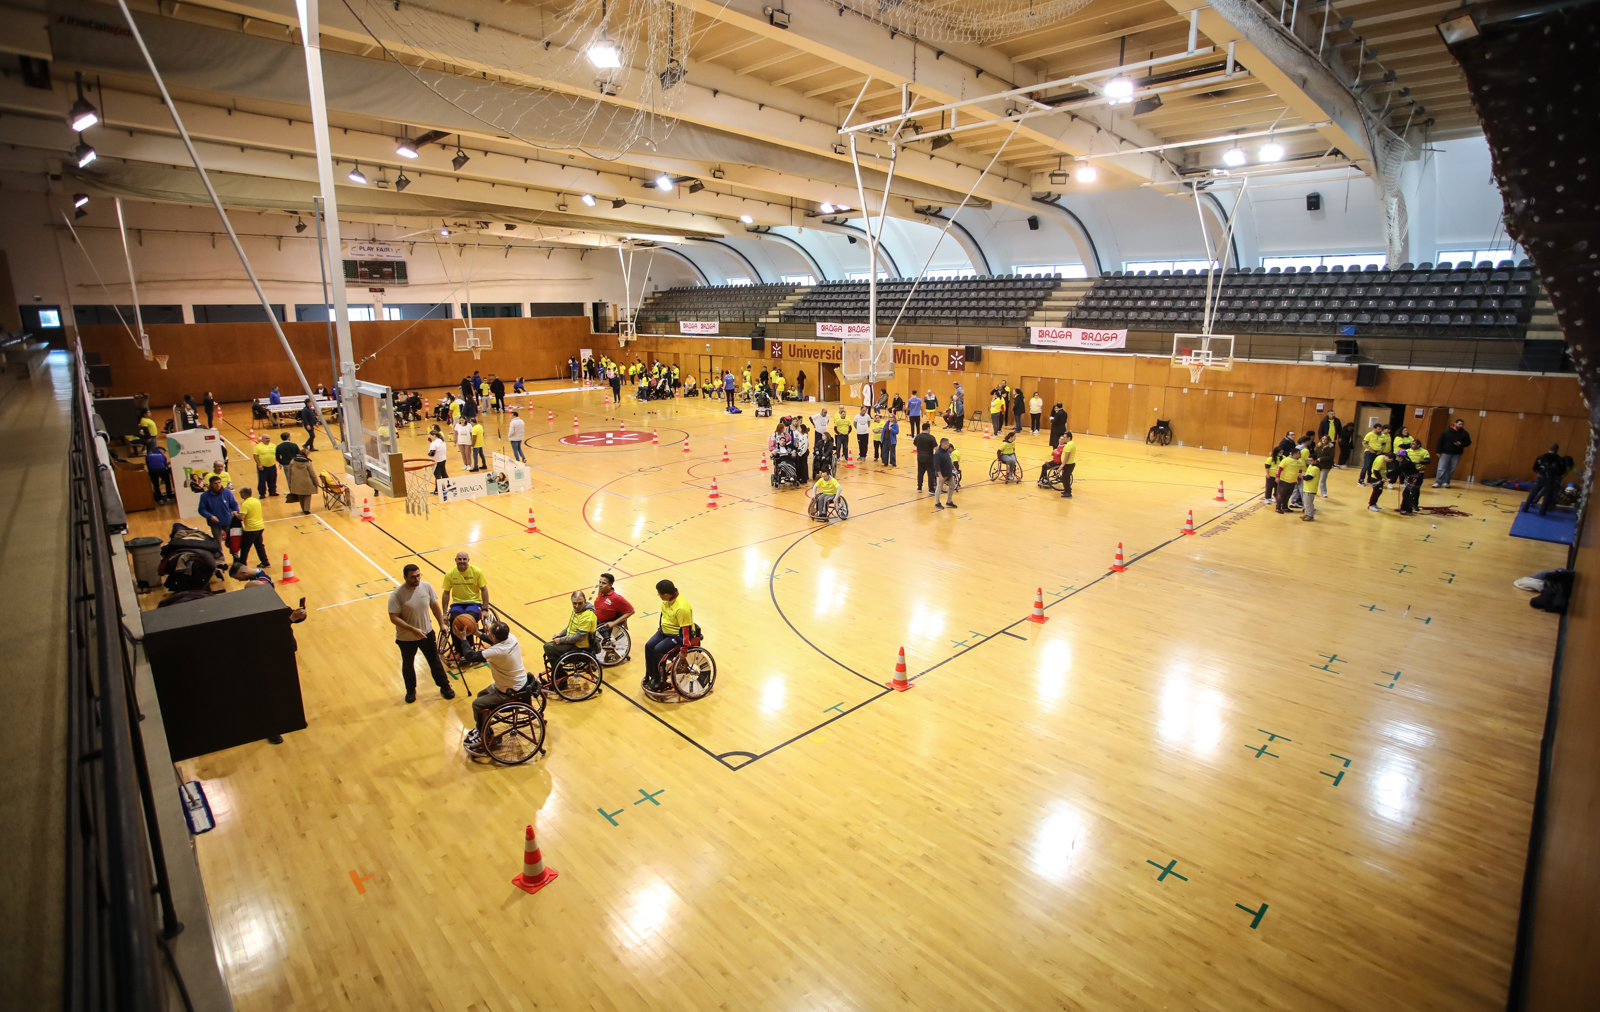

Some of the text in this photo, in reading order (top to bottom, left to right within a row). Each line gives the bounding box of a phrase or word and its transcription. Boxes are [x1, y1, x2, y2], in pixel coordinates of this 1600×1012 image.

[821, 324, 870, 333] BRAGA BRAGA
[1038, 329, 1118, 342] BRAGA BRAGA
[893, 348, 940, 366] Minho
[460, 484, 483, 494] BRAGA
